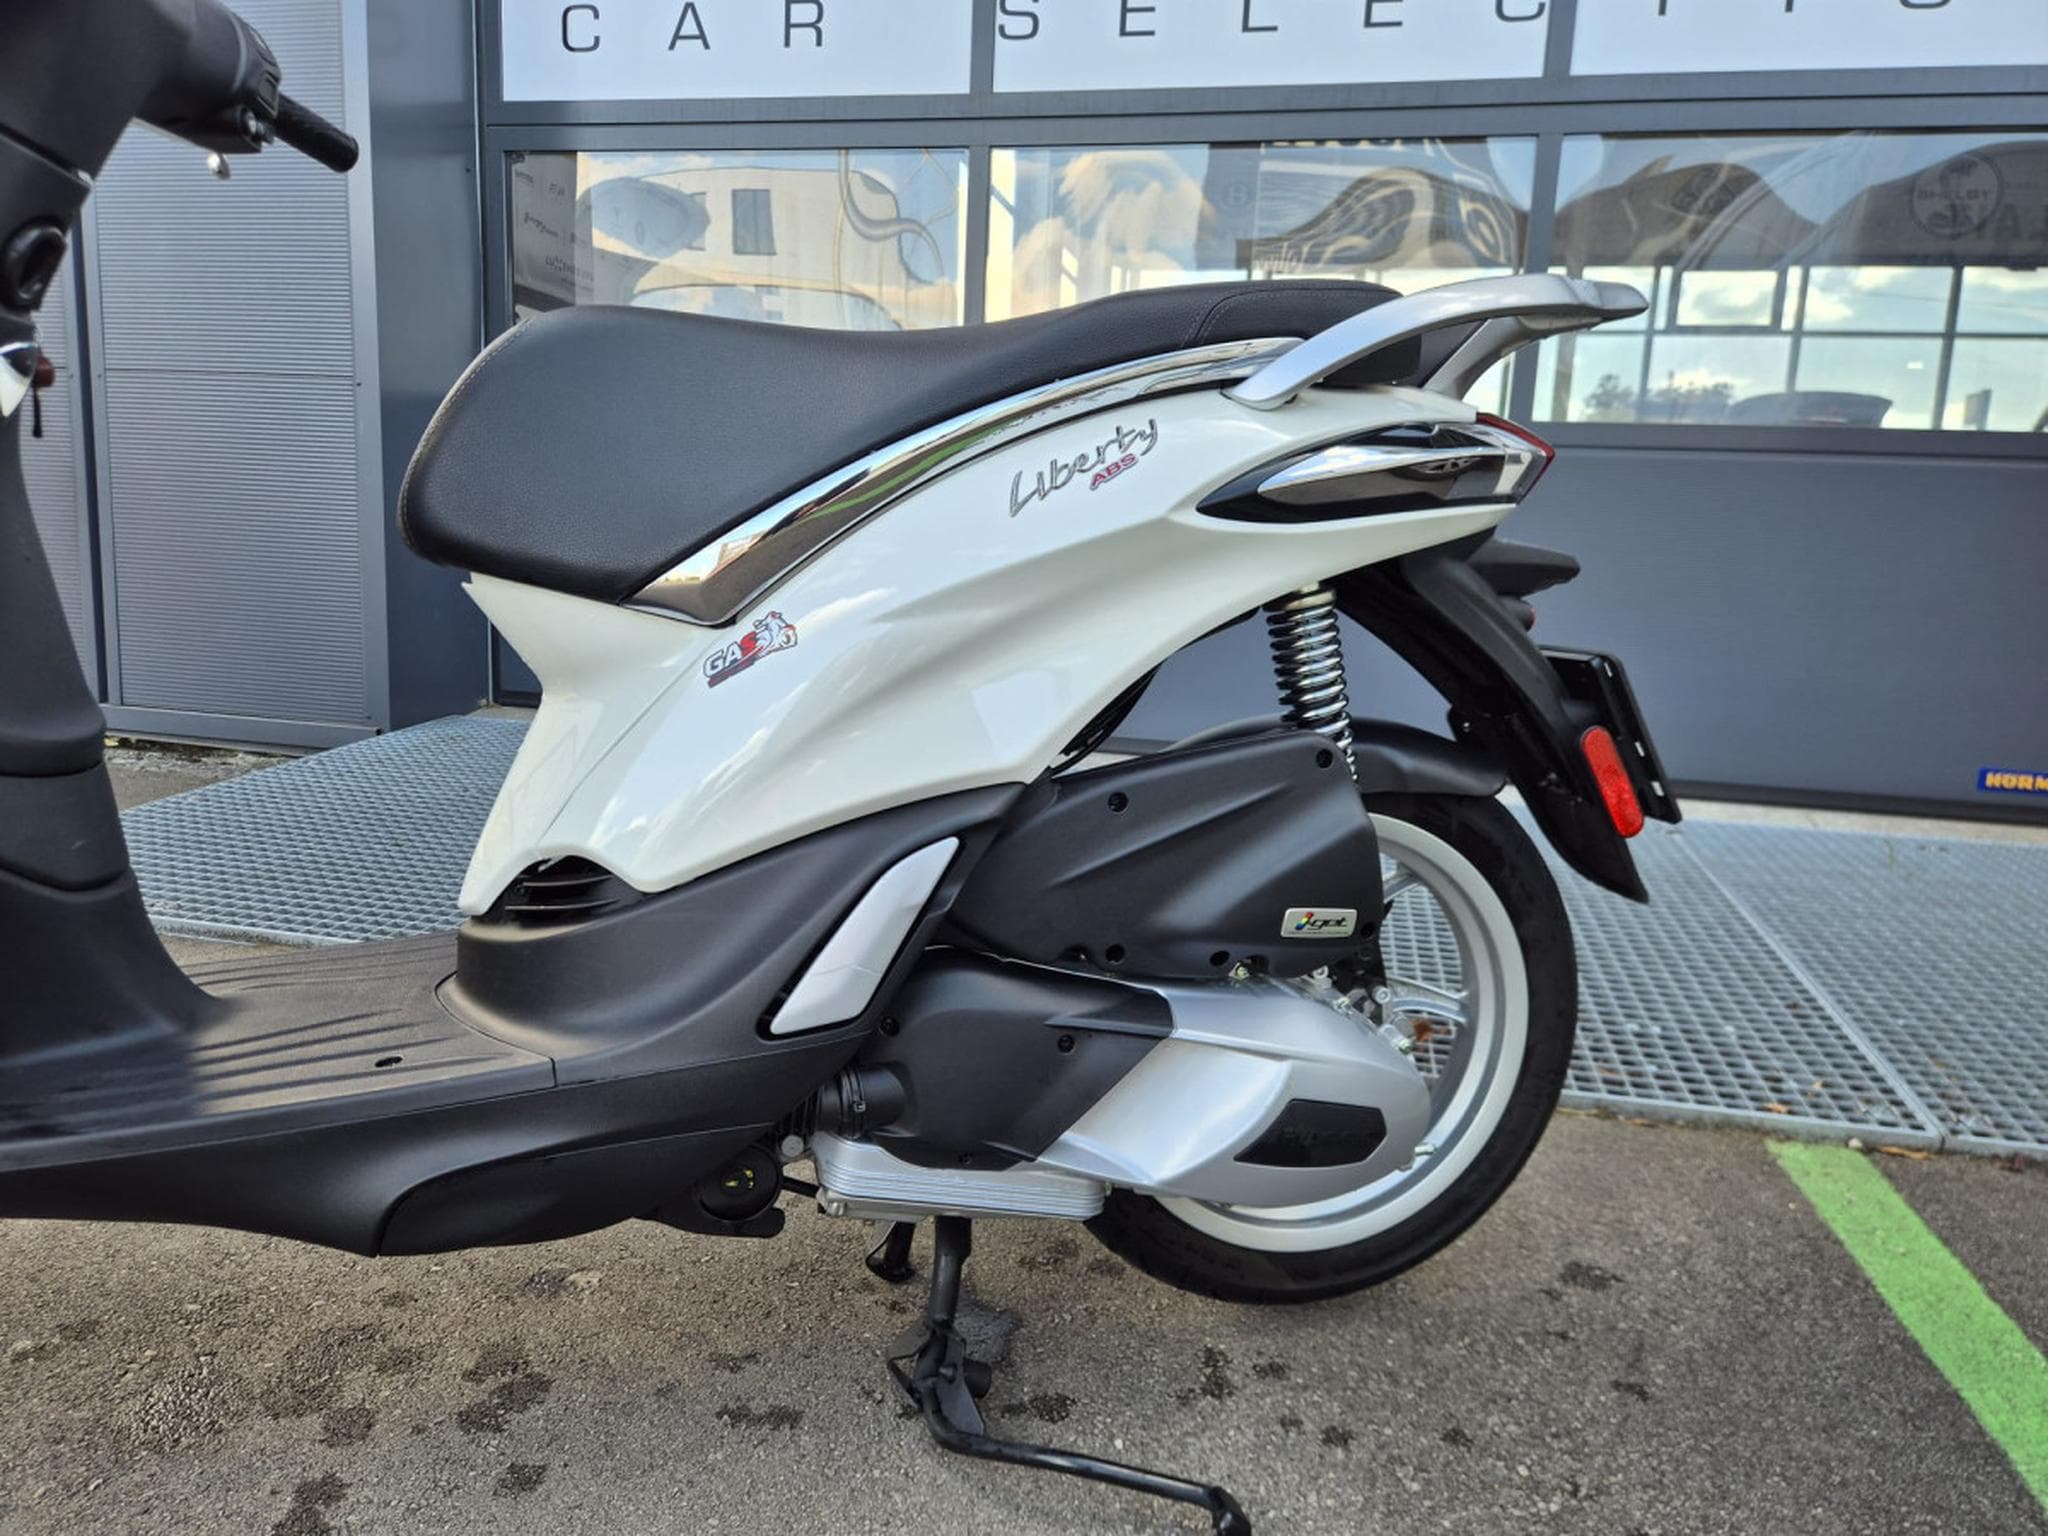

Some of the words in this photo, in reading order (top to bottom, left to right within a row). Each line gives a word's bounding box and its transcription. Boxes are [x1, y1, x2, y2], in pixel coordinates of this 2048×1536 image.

[561, 0, 826, 53] CAR
[1009, 418, 1158, 518] Liberty
[1090, 452, 1138, 491] ABS
